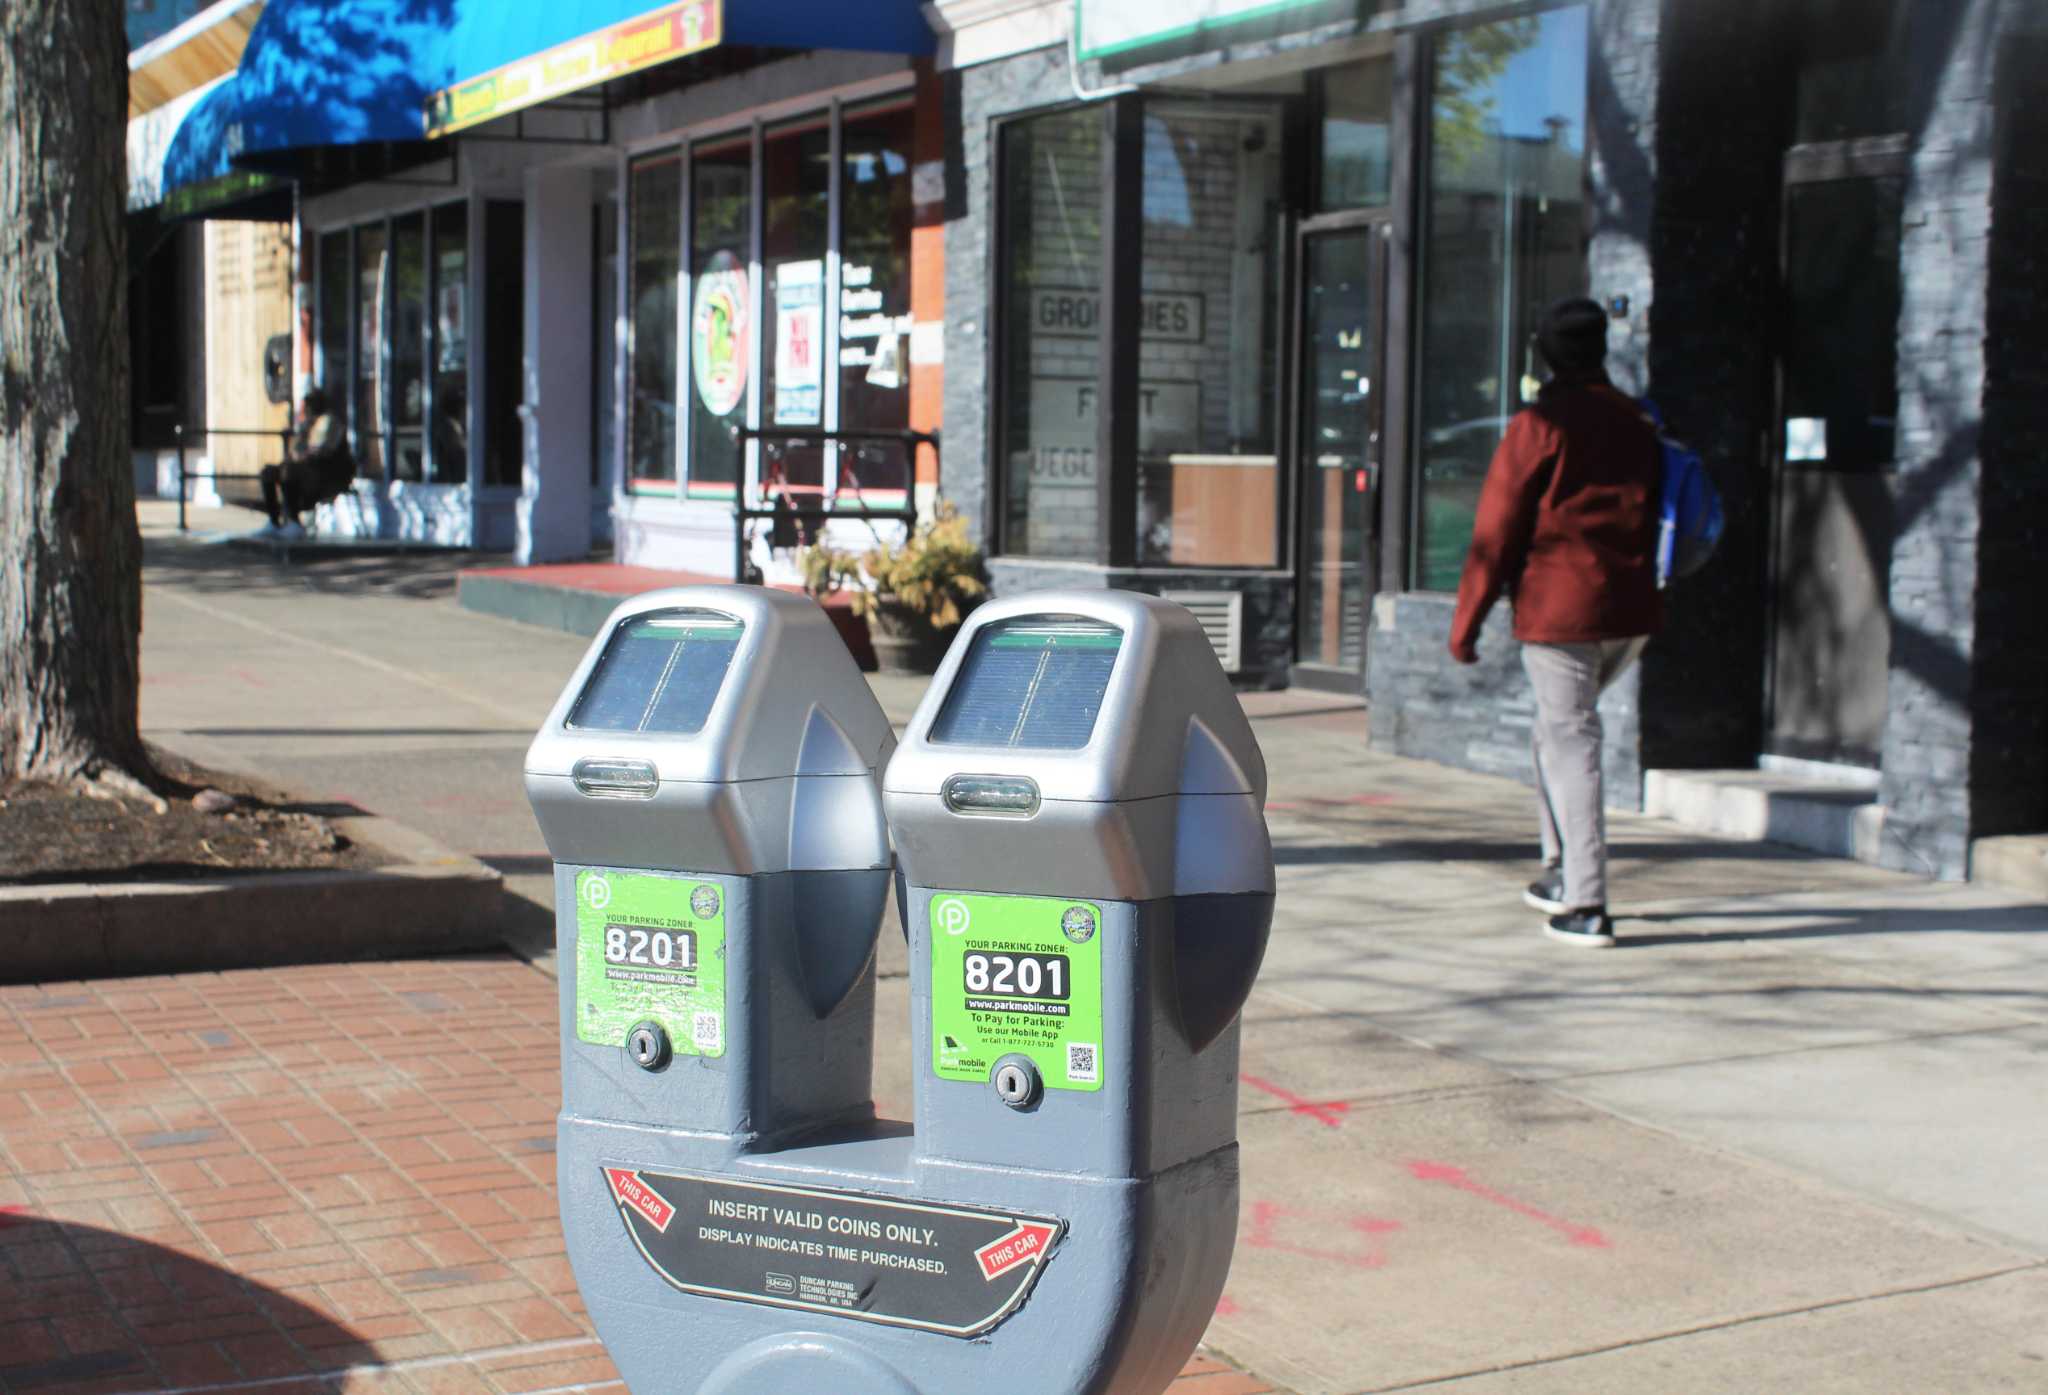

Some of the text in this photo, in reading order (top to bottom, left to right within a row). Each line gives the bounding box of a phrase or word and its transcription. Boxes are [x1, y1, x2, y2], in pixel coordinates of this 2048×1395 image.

[607, 914, 628, 923] YOUR
[630, 915, 665, 926] PARKING
[606, 928, 690, 967] 8201
[965, 939, 989, 949] YOUR
[992, 941, 1032, 951] PARKING
[965, 955, 1062, 996] 8201
[969, 1000, 1066, 1014] www.parkmobile.com
[972, 1013, 1065, 1030] To Pay for Parking:
[977, 1025, 1058, 1040] Use our Mobile App
[618, 1175, 662, 1218] THIS CAR
[708, 1199, 938, 1247] INSERT VALID COINS ONLY.
[699, 1226, 752, 1246] DISPLAY
[755, 1234, 824, 1257] INDICATES
[827, 1245, 858, 1262] TIME
[987, 1233, 1038, 1268] THIS CAR
[800, 1275, 854, 1291] DUNCAN PARKING
